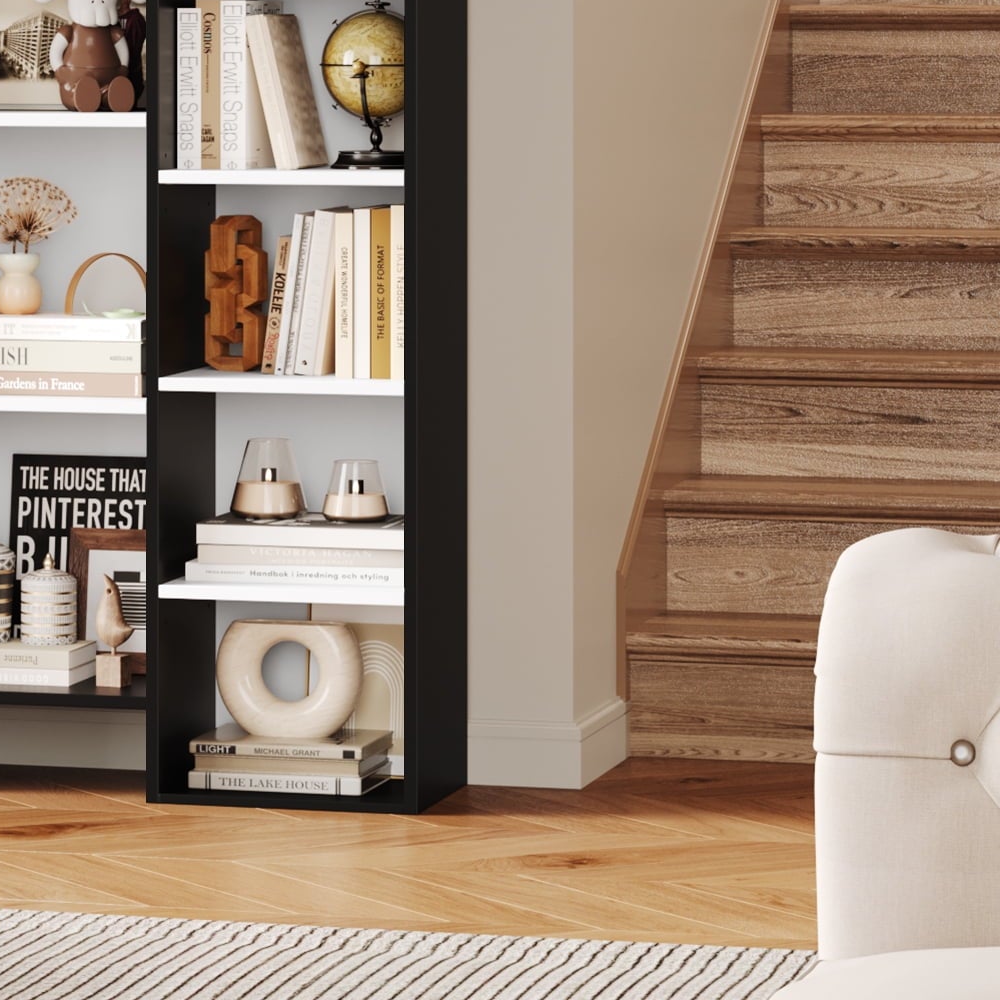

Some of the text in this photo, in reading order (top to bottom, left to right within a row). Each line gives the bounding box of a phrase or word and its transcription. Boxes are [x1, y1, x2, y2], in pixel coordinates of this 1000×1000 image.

[202, 12, 216, 54] Cosmos
[179, 12, 199, 152] Elliott Erwitt Snaps
[223, 4, 243, 152] Elliott Erwitt Snaps
[376, 245, 385, 341] THE BASIC OF FORMAT
[3, 323, 16, 335] IT
[38, 378, 48, 390] in
[51, 378, 85, 391] France
[20, 466, 146, 493] THE HOUSE THAT
[17, 496, 146, 530] PINTEREST
[250, 569, 288, 577] Handbok
[296, 571, 338, 580] inredning
[341, 572, 357, 580] och
[360, 573, 389, 582] styling
[199, 744, 231, 754] LIGHT
[253, 747, 320, 757] MICHAEL GRANT
[218, 777, 329, 791] THE LAKE HOUSE
